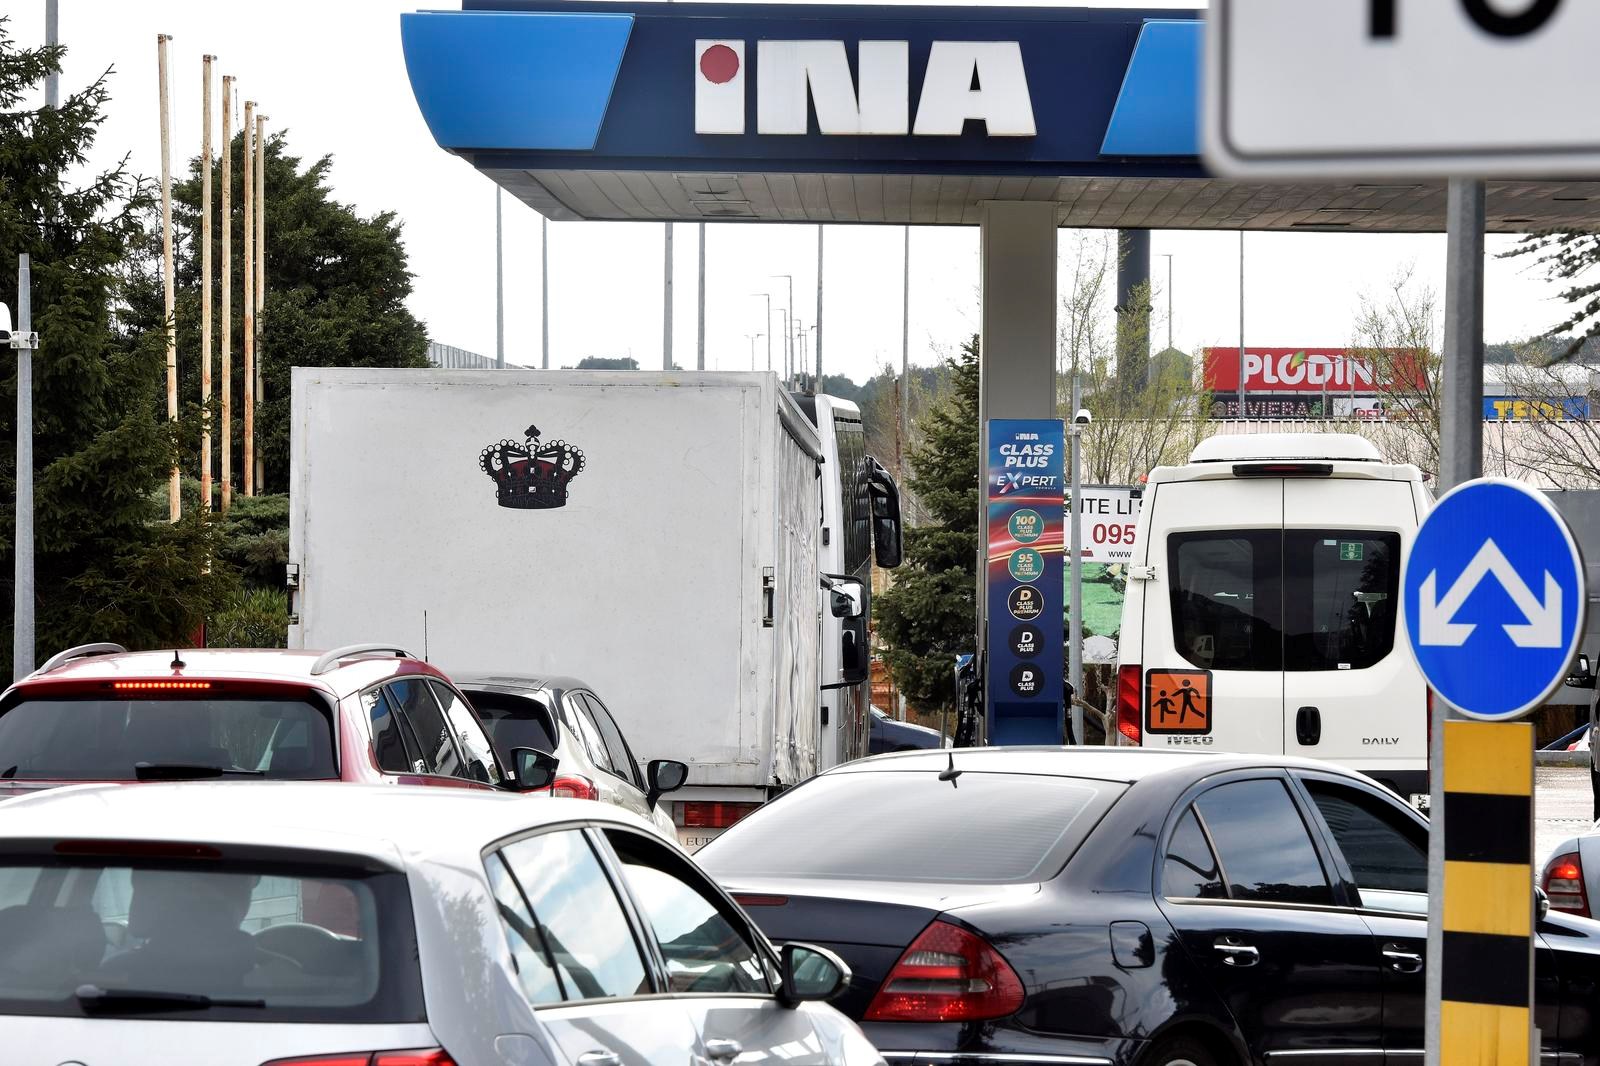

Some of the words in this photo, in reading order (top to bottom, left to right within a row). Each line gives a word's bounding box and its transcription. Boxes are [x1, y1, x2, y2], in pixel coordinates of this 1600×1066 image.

[1000, 444, 1054, 456] CLASS
[1005, 456, 1049, 468] PLUS
[997, 472, 1057, 493] EXPERT
[1015, 516, 1036, 525] 100
[1093, 523, 1136, 545] 095
[1018, 553, 1034, 563] 95
[1020, 590, 1032, 601] D
[1021, 632, 1033, 643] D
[1167, 736, 1213, 746] IVECO
[1362, 737, 1399, 745] DAILY
